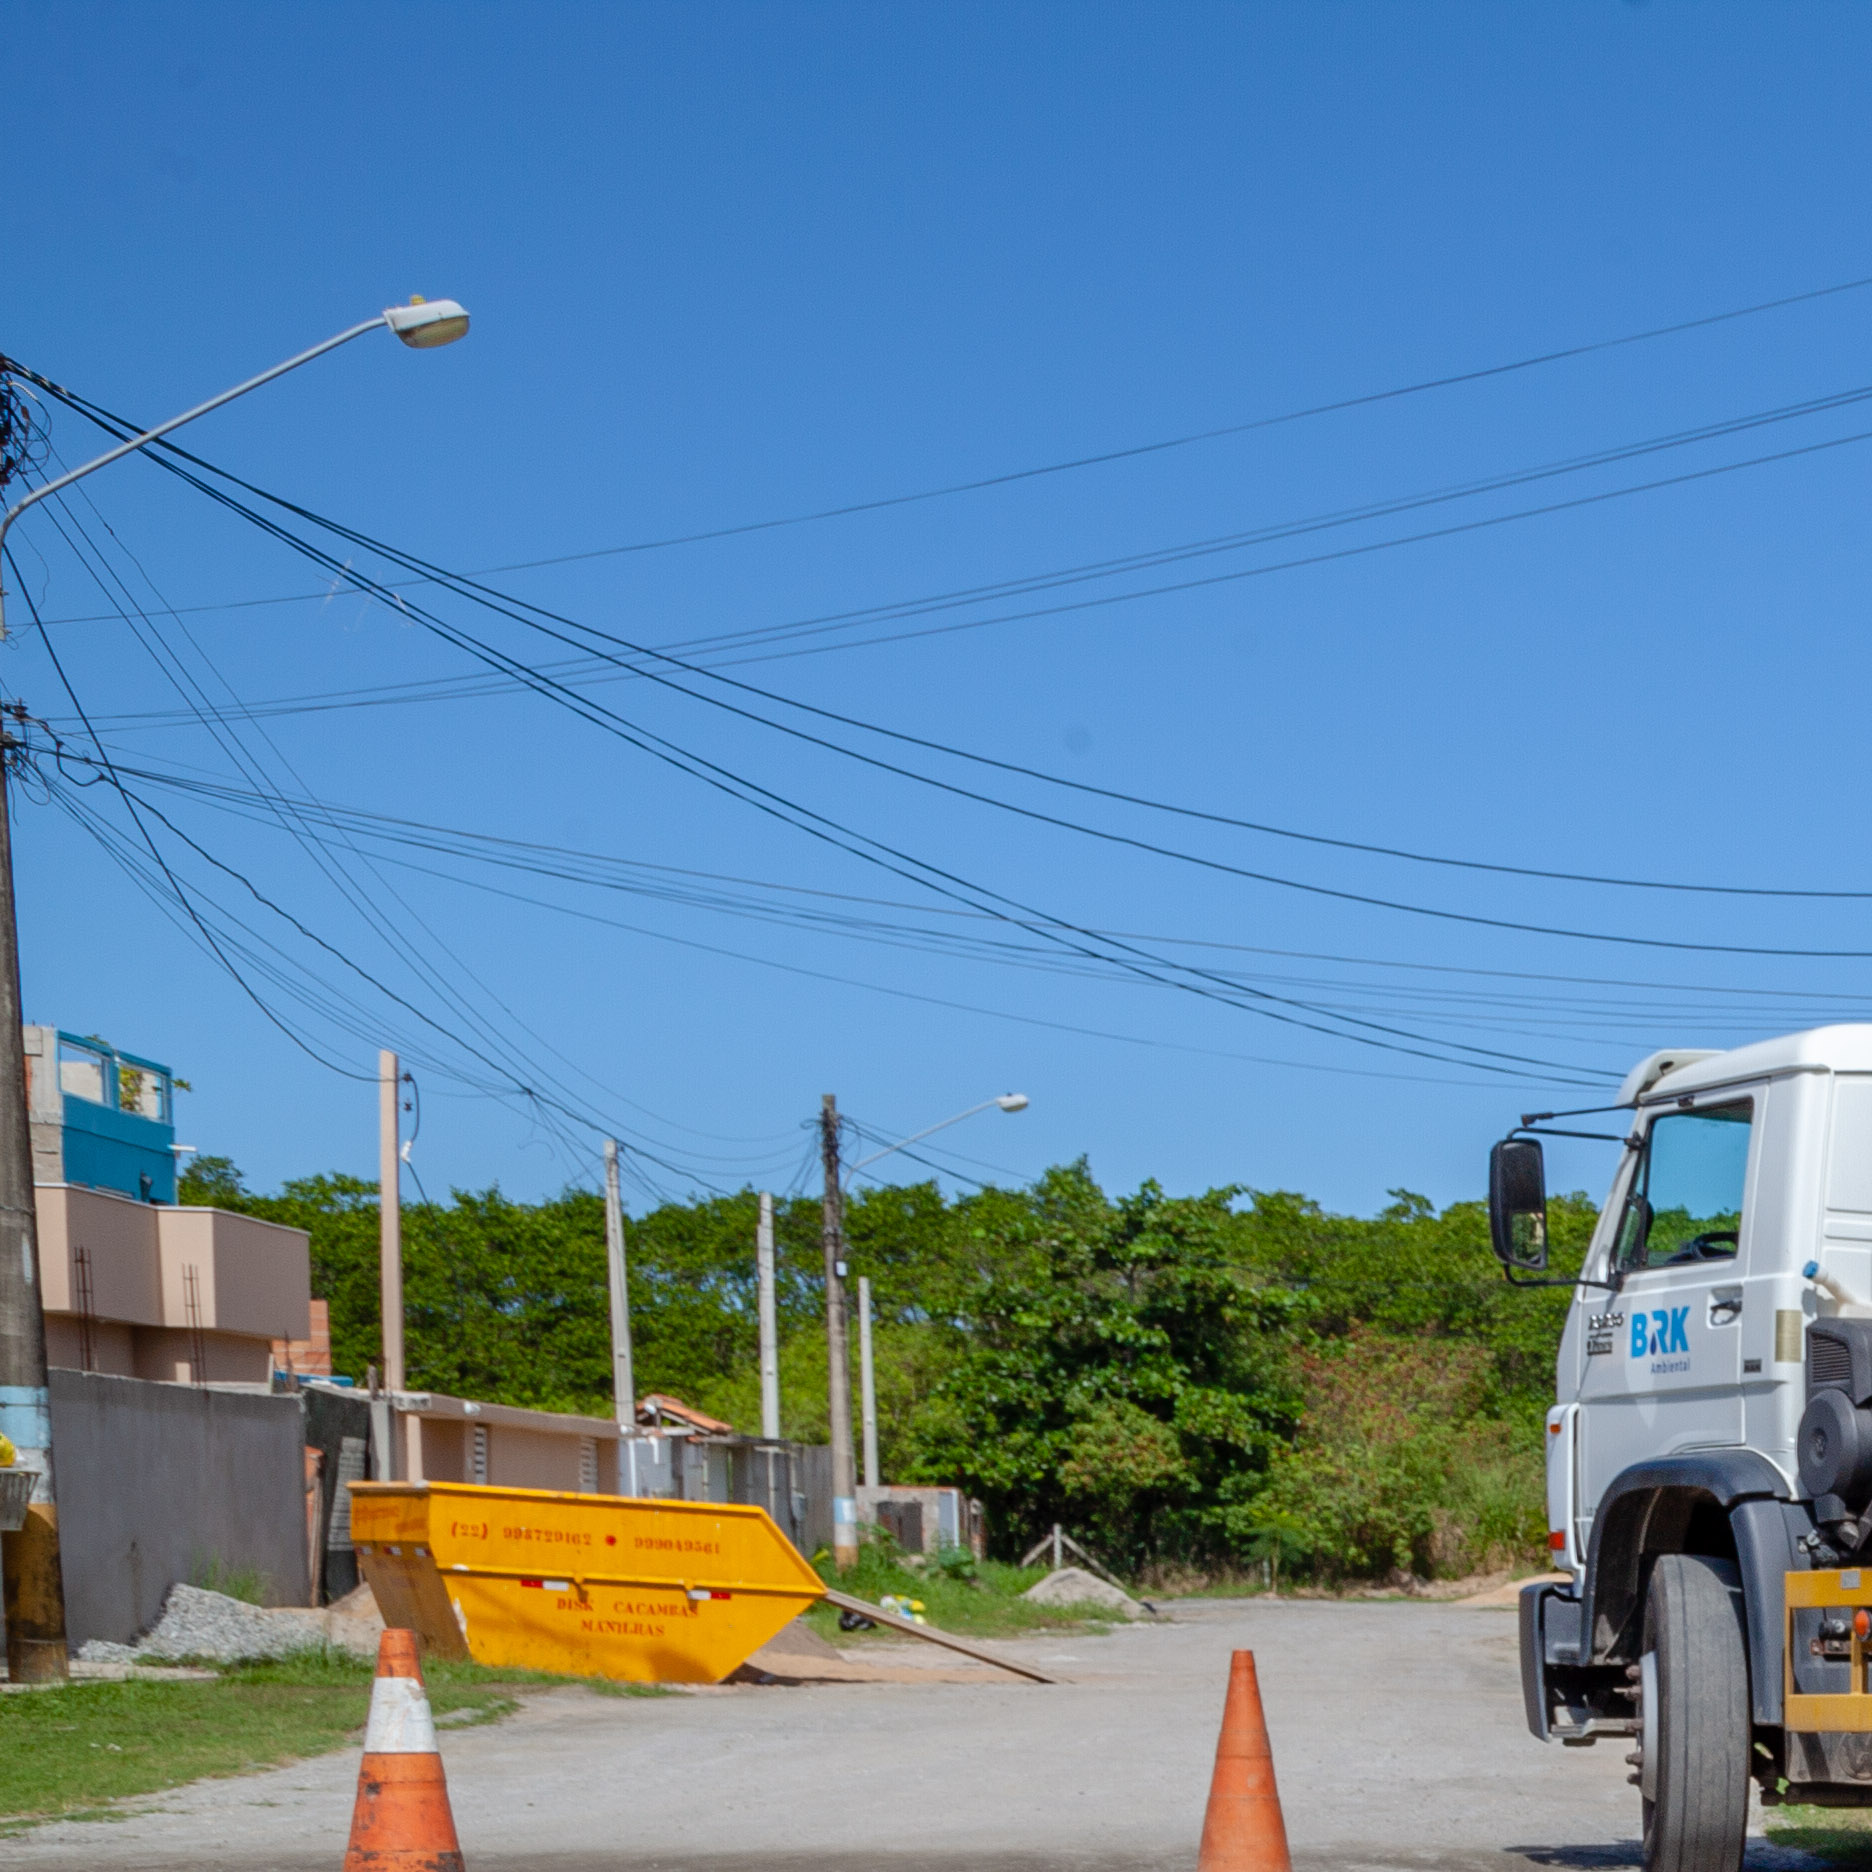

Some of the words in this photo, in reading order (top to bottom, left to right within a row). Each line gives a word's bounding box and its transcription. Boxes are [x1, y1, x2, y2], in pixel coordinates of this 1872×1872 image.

[1630, 1306, 1690, 1359] BRK
[1651, 1358, 1690, 1374] Ambiental
[451, 1521, 488, 1540] (22)
[557, 1598, 594, 1612] DISK
[582, 1619, 665, 1636] MANILHAS
